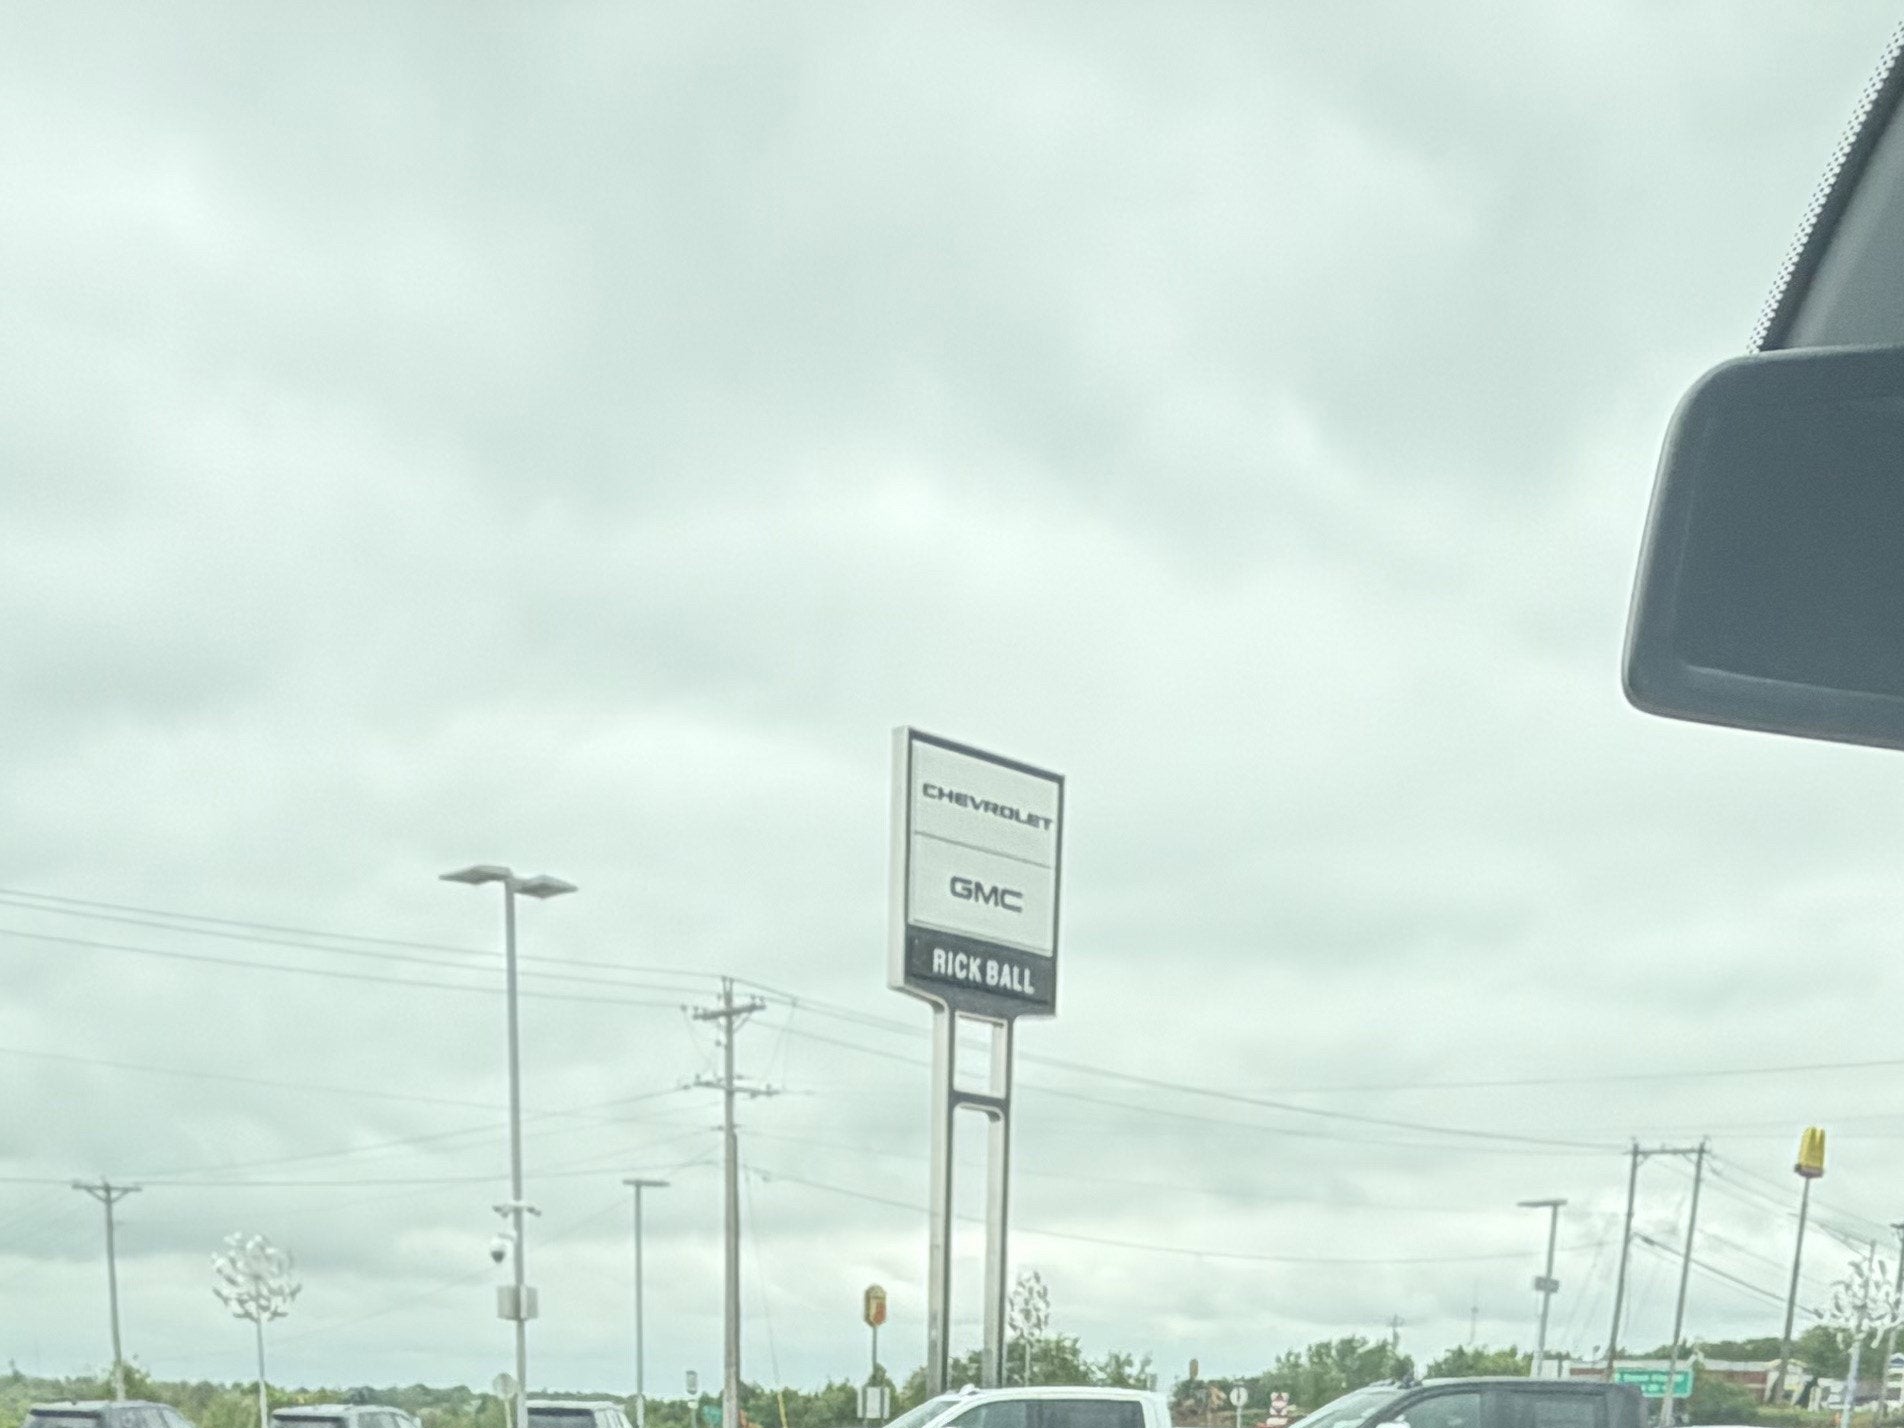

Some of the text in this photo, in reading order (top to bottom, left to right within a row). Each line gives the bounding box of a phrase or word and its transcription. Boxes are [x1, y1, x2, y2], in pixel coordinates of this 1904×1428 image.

[922, 782, 1054, 832] CHEVROLET
[949, 875, 1024, 913] GMC
[932, 947, 1036, 995] RICK BALL
